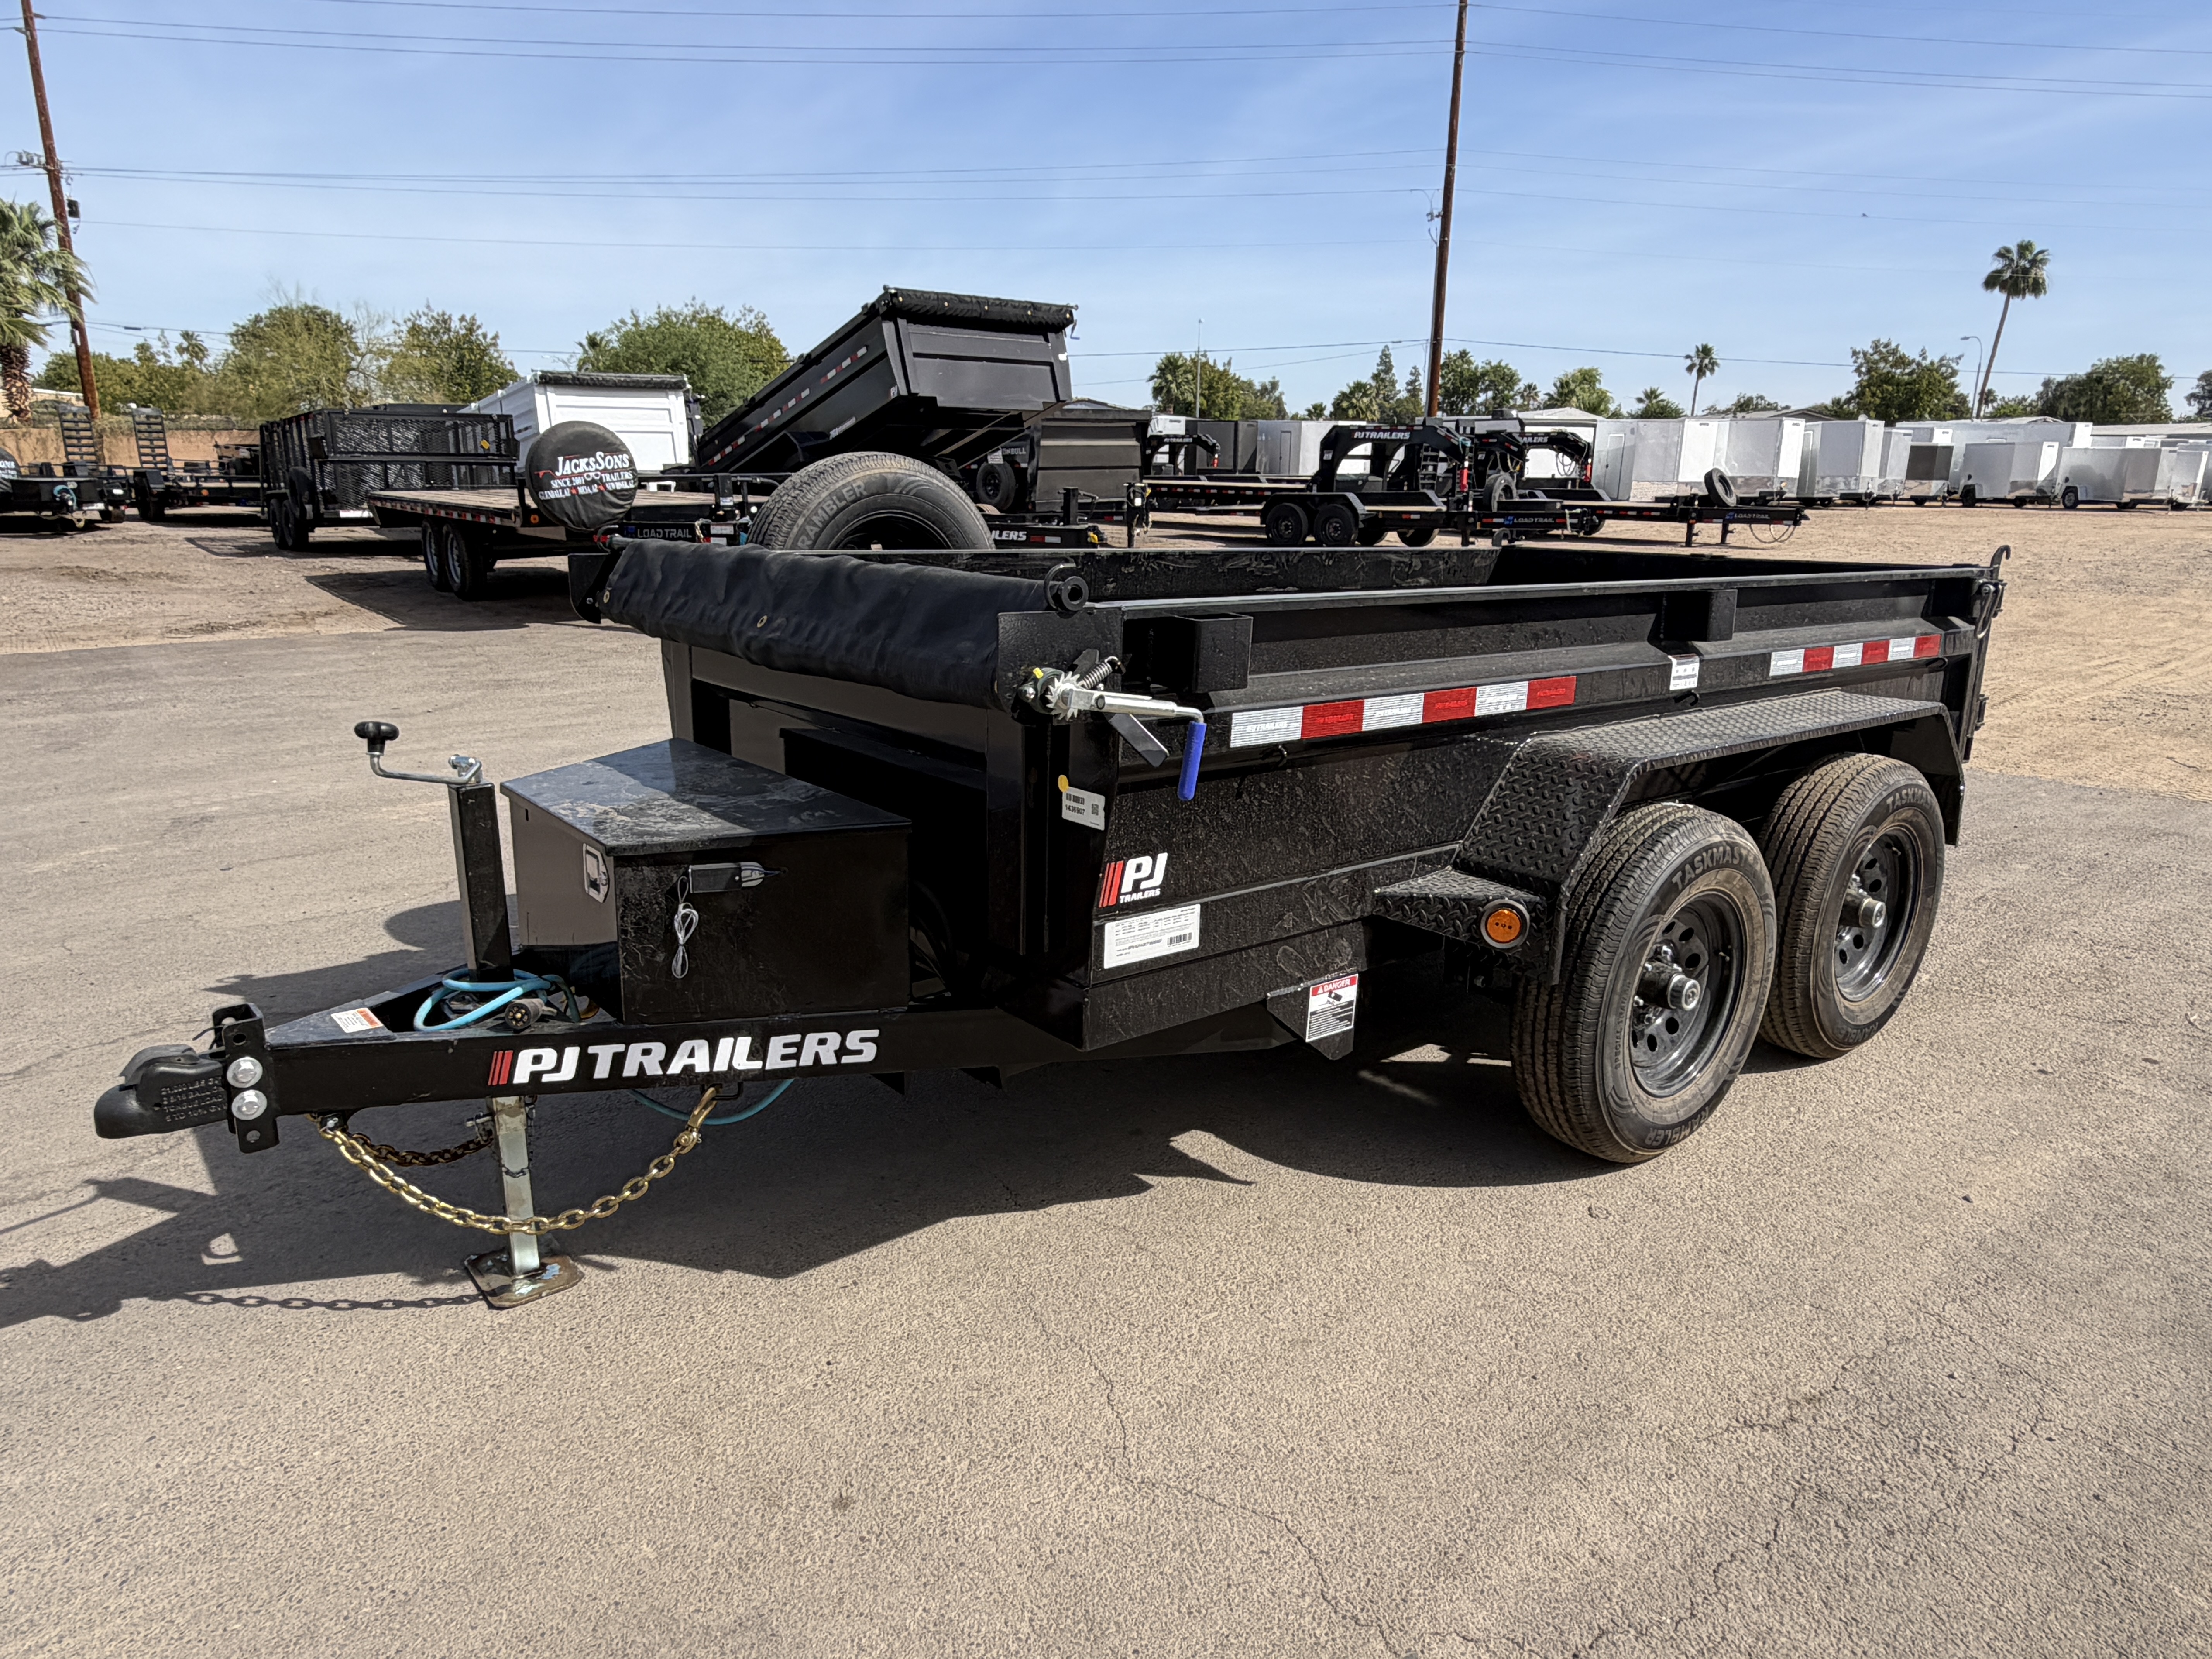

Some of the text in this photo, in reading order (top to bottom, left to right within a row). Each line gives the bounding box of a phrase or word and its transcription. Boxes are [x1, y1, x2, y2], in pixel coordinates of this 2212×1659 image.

[797, 481, 867, 550] RAMBLER
[637, 528, 692, 538] LOAD TRAIL
[991, 530, 1027, 541] ILERS
[1121, 852, 1168, 893] PJ
[1120, 888, 1161, 903] TRAILERS
[1323, 979, 1350, 993] DANGER
[587, 1029, 880, 1079] TRAILERS
[1644, 1106, 1710, 1147] RAMBLER
